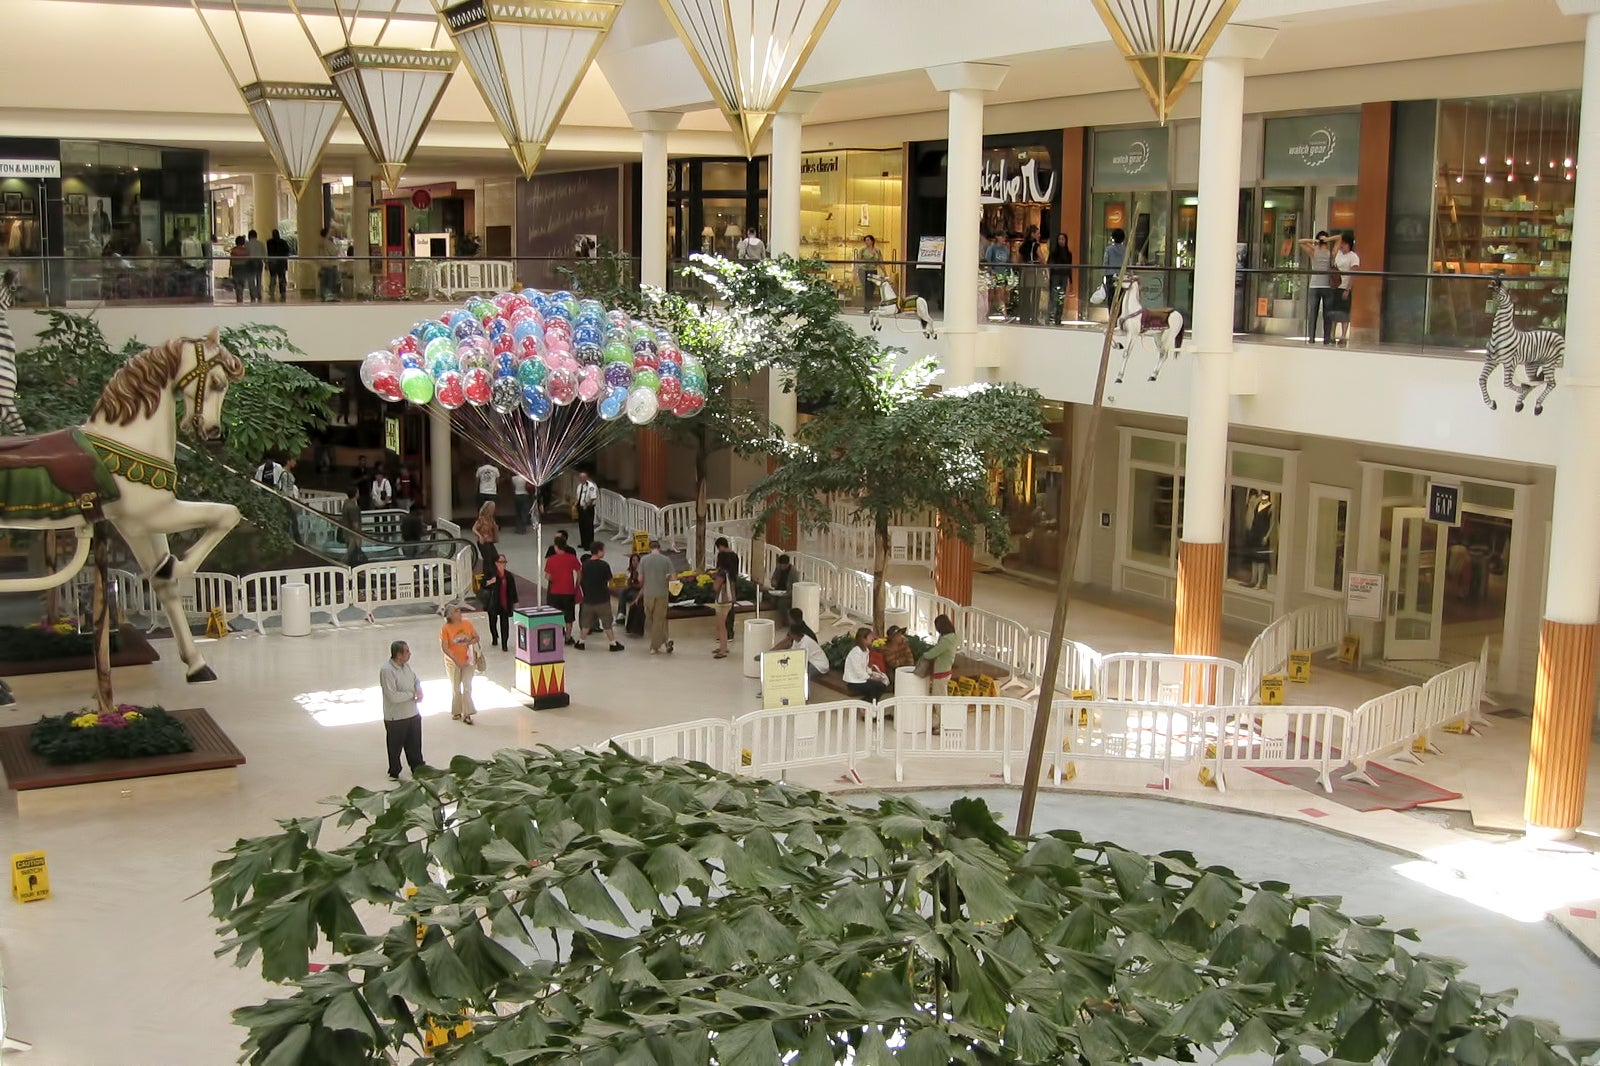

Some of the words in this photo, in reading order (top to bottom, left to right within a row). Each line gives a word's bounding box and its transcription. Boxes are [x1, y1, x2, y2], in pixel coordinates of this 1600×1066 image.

[1289, 144, 1309, 155] watch
[1310, 145, 1327, 157] gear
[817, 156, 838, 172] david
[1435, 497, 1453, 516] GAP
[16, 857, 45, 869] CAUTION
[20, 867, 43, 875] WATCH
